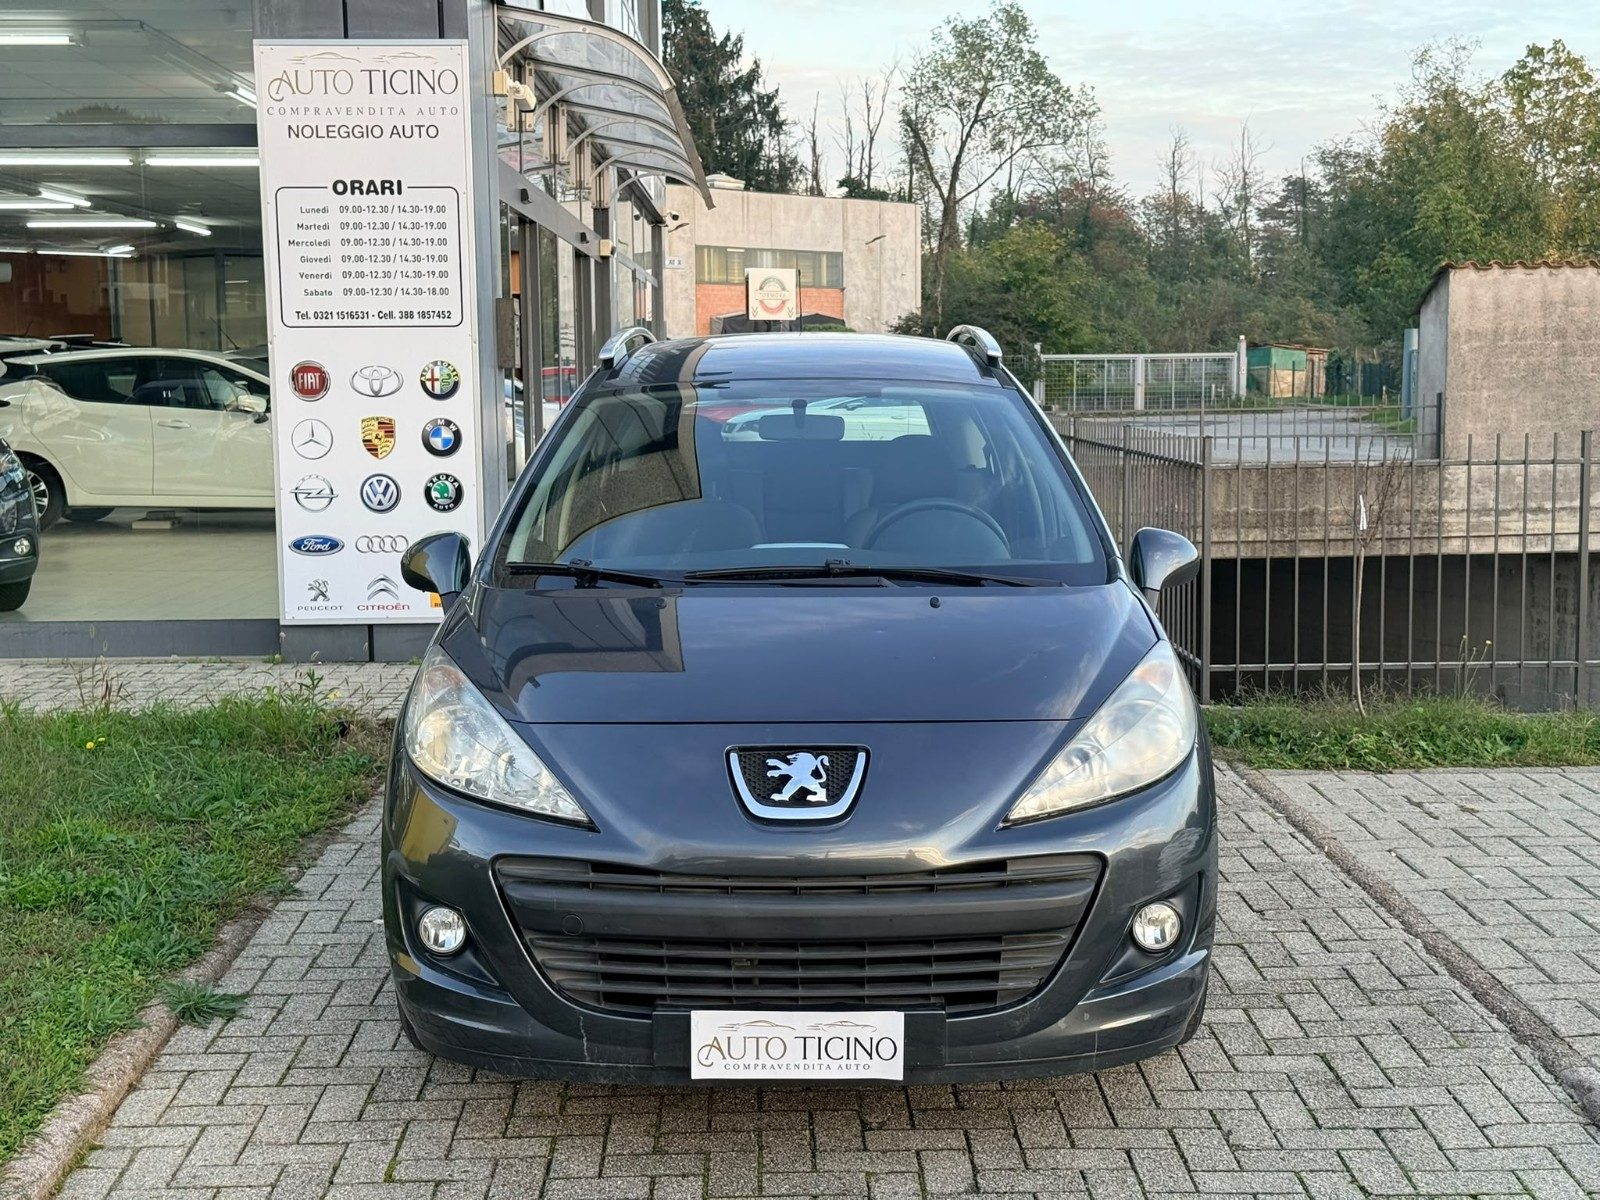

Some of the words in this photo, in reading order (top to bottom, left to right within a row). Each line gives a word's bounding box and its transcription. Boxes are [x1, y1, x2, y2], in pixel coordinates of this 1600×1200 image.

[268, 69, 354, 102] AUTO
[360, 69, 459, 95] TICINO
[266, 106, 406, 116] COMPRAVENDITA
[417, 106, 459, 116] AUTO
[287, 124, 384, 139] NOLEGGIO
[389, 124, 439, 139] AUTO
[332, 179, 403, 196] ORARI
[339, 205, 389, 214] 09.00-12.30
[397, 205, 446, 214] 14.30-19.00
[340, 221, 390, 231] 09.00-12.30
[398, 221, 447, 230] 14.30-19.00
[340, 238, 390, 247] 09.00-12.30
[399, 237, 448, 246] 14.30-19.00
[341, 254, 391, 263] 09.00-12.30
[399, 254, 448, 263] 14.30-19.00
[342, 270, 392, 279] 09.00-12.30
[400, 270, 449, 279] 14.30-19.00
[303, 289, 333, 297] Sabato
[343, 287, 392, 296] 09.00-12.30
[401, 287, 450, 296] 14.30-18.00
[295, 310, 311, 320] Tel.
[313, 310, 334, 320] 0321
[336, 310, 369, 320] 1516531
[377, 310, 396, 320] Cell.
[398, 310, 415, 320] 388
[417, 310, 452, 320] 1857452
[297, 372, 321, 390] FIAT
[425, 419, 458, 432] BMW
[301, 538, 331, 551] Ford
[697, 1036, 787, 1068] AUTO
[794, 1036, 898, 1061] TICINO
[724, 1063, 832, 1071] COMPRAVENDITA
[837, 1063, 871, 1071] AUTO
